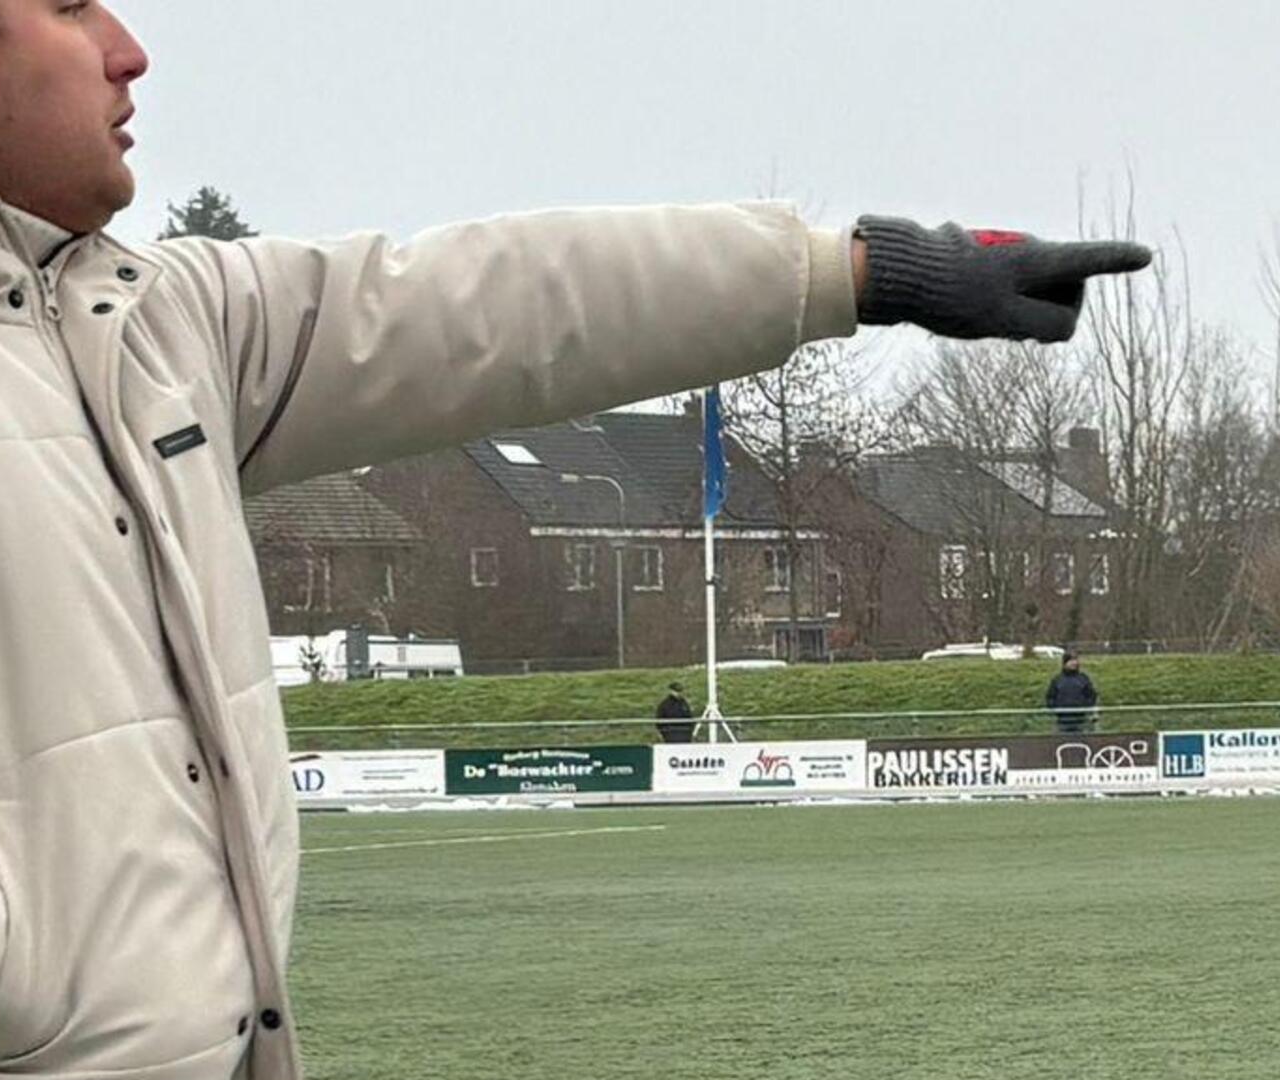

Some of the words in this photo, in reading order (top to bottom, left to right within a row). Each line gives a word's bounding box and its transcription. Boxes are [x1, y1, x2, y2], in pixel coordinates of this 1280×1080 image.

[869, 748, 1008, 773] PAULISSEN
[1164, 754, 1204, 775] HLB
[464, 764, 486, 778] De
[874, 770, 1007, 788] BAKKERIJEN
